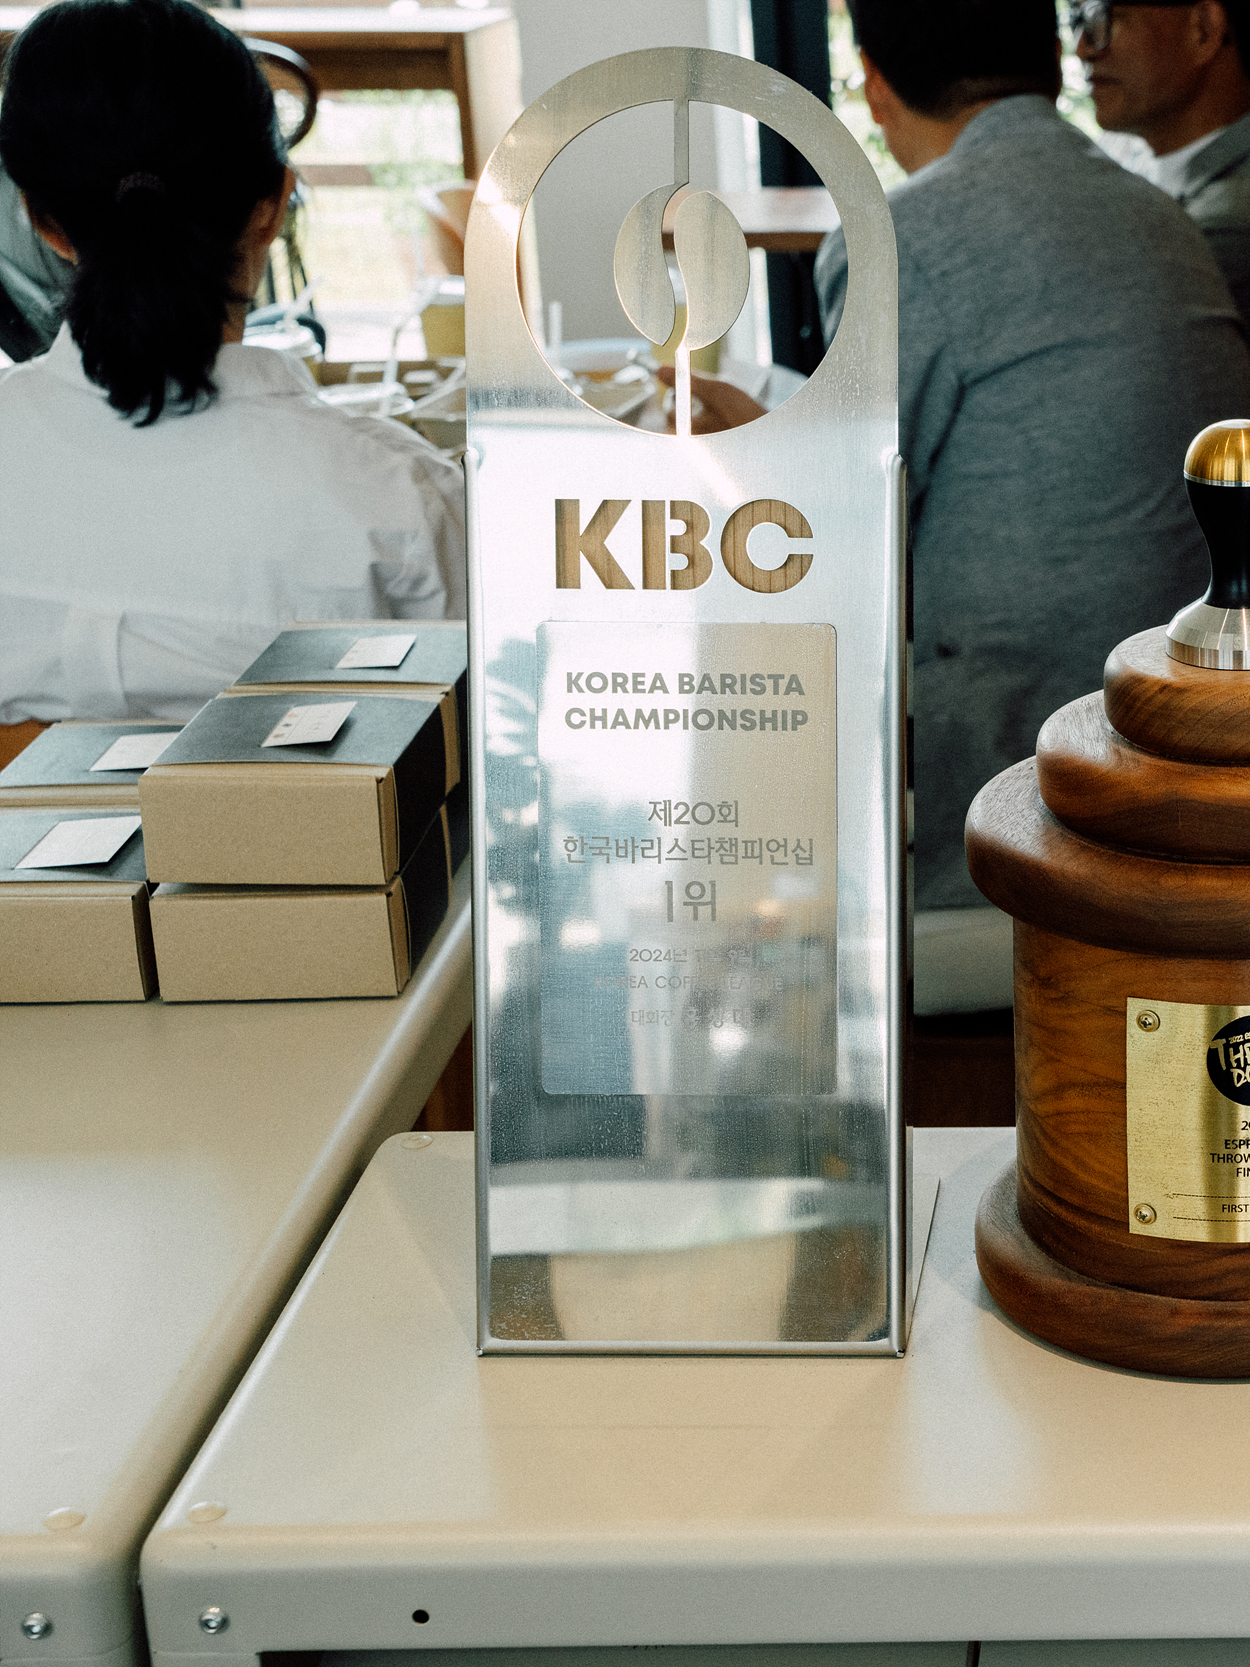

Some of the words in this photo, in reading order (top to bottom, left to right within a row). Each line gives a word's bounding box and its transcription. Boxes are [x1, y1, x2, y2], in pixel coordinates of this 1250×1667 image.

[554, 498, 814, 594] KBC
[565, 671, 670, 695] KOREA
[677, 673, 806, 697] BARISTA
[564, 707, 809, 732] CHAMPIONSHIP
[647, 799, 740, 828] 제20회
[562, 835, 815, 866] 한국바리스타챔피언십
[663, 879, 718, 923] 1위
[1221, 1203, 1250, 1213] FIRST
